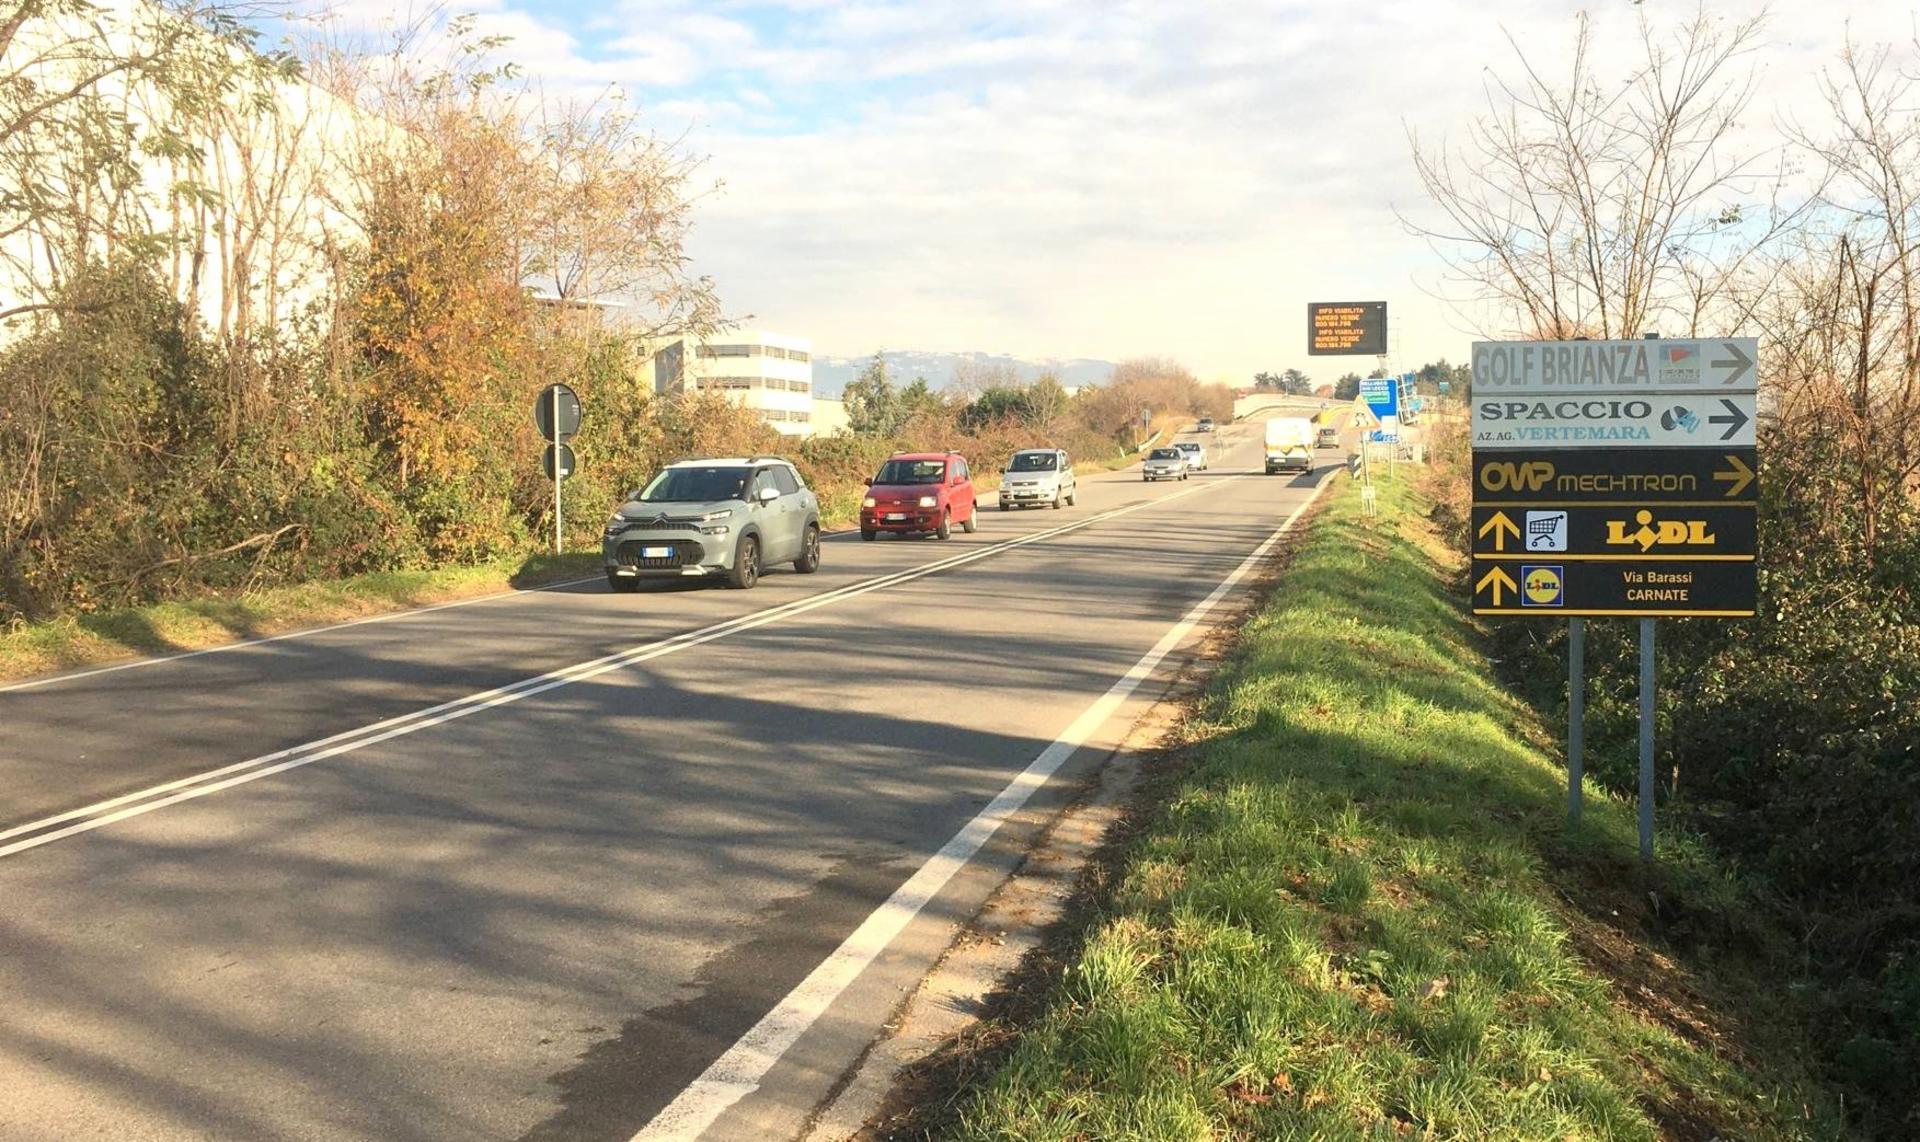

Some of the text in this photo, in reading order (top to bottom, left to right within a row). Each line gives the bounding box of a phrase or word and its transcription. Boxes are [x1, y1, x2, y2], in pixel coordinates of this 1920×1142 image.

[1473, 345, 1650, 387] GOLF BRIANZA
[1479, 401, 1652, 421] SPACCIO
[1516, 426, 1651, 440] VERTEMARA
[1623, 571, 1692, 583] Via Barassi
[1627, 589, 1689, 601] CARNATE
